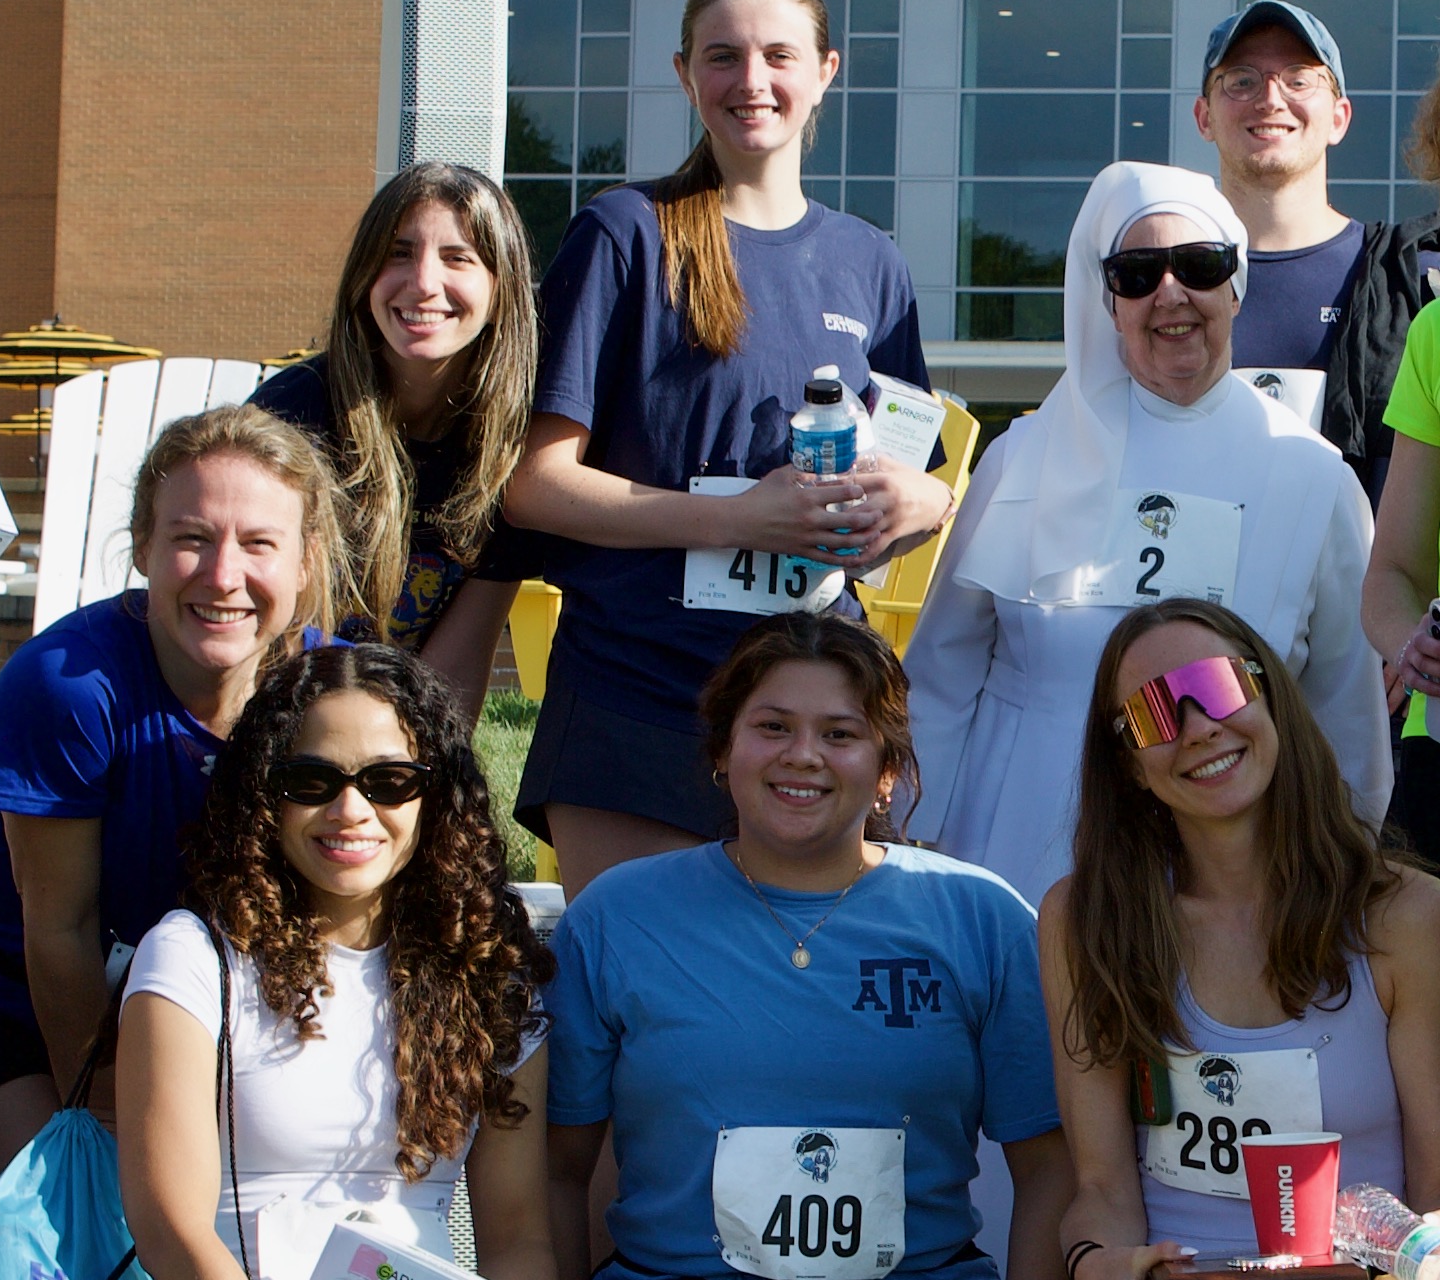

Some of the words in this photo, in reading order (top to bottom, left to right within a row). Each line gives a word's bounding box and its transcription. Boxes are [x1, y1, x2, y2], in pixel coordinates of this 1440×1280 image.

[887, 402, 935, 426] GARNIER
[728, 548, 807, 598] 413
[1136, 547, 1165, 596] 2
[761, 1194, 862, 1258] 409
[1277, 1165, 1297, 1237] DUNKIN'
